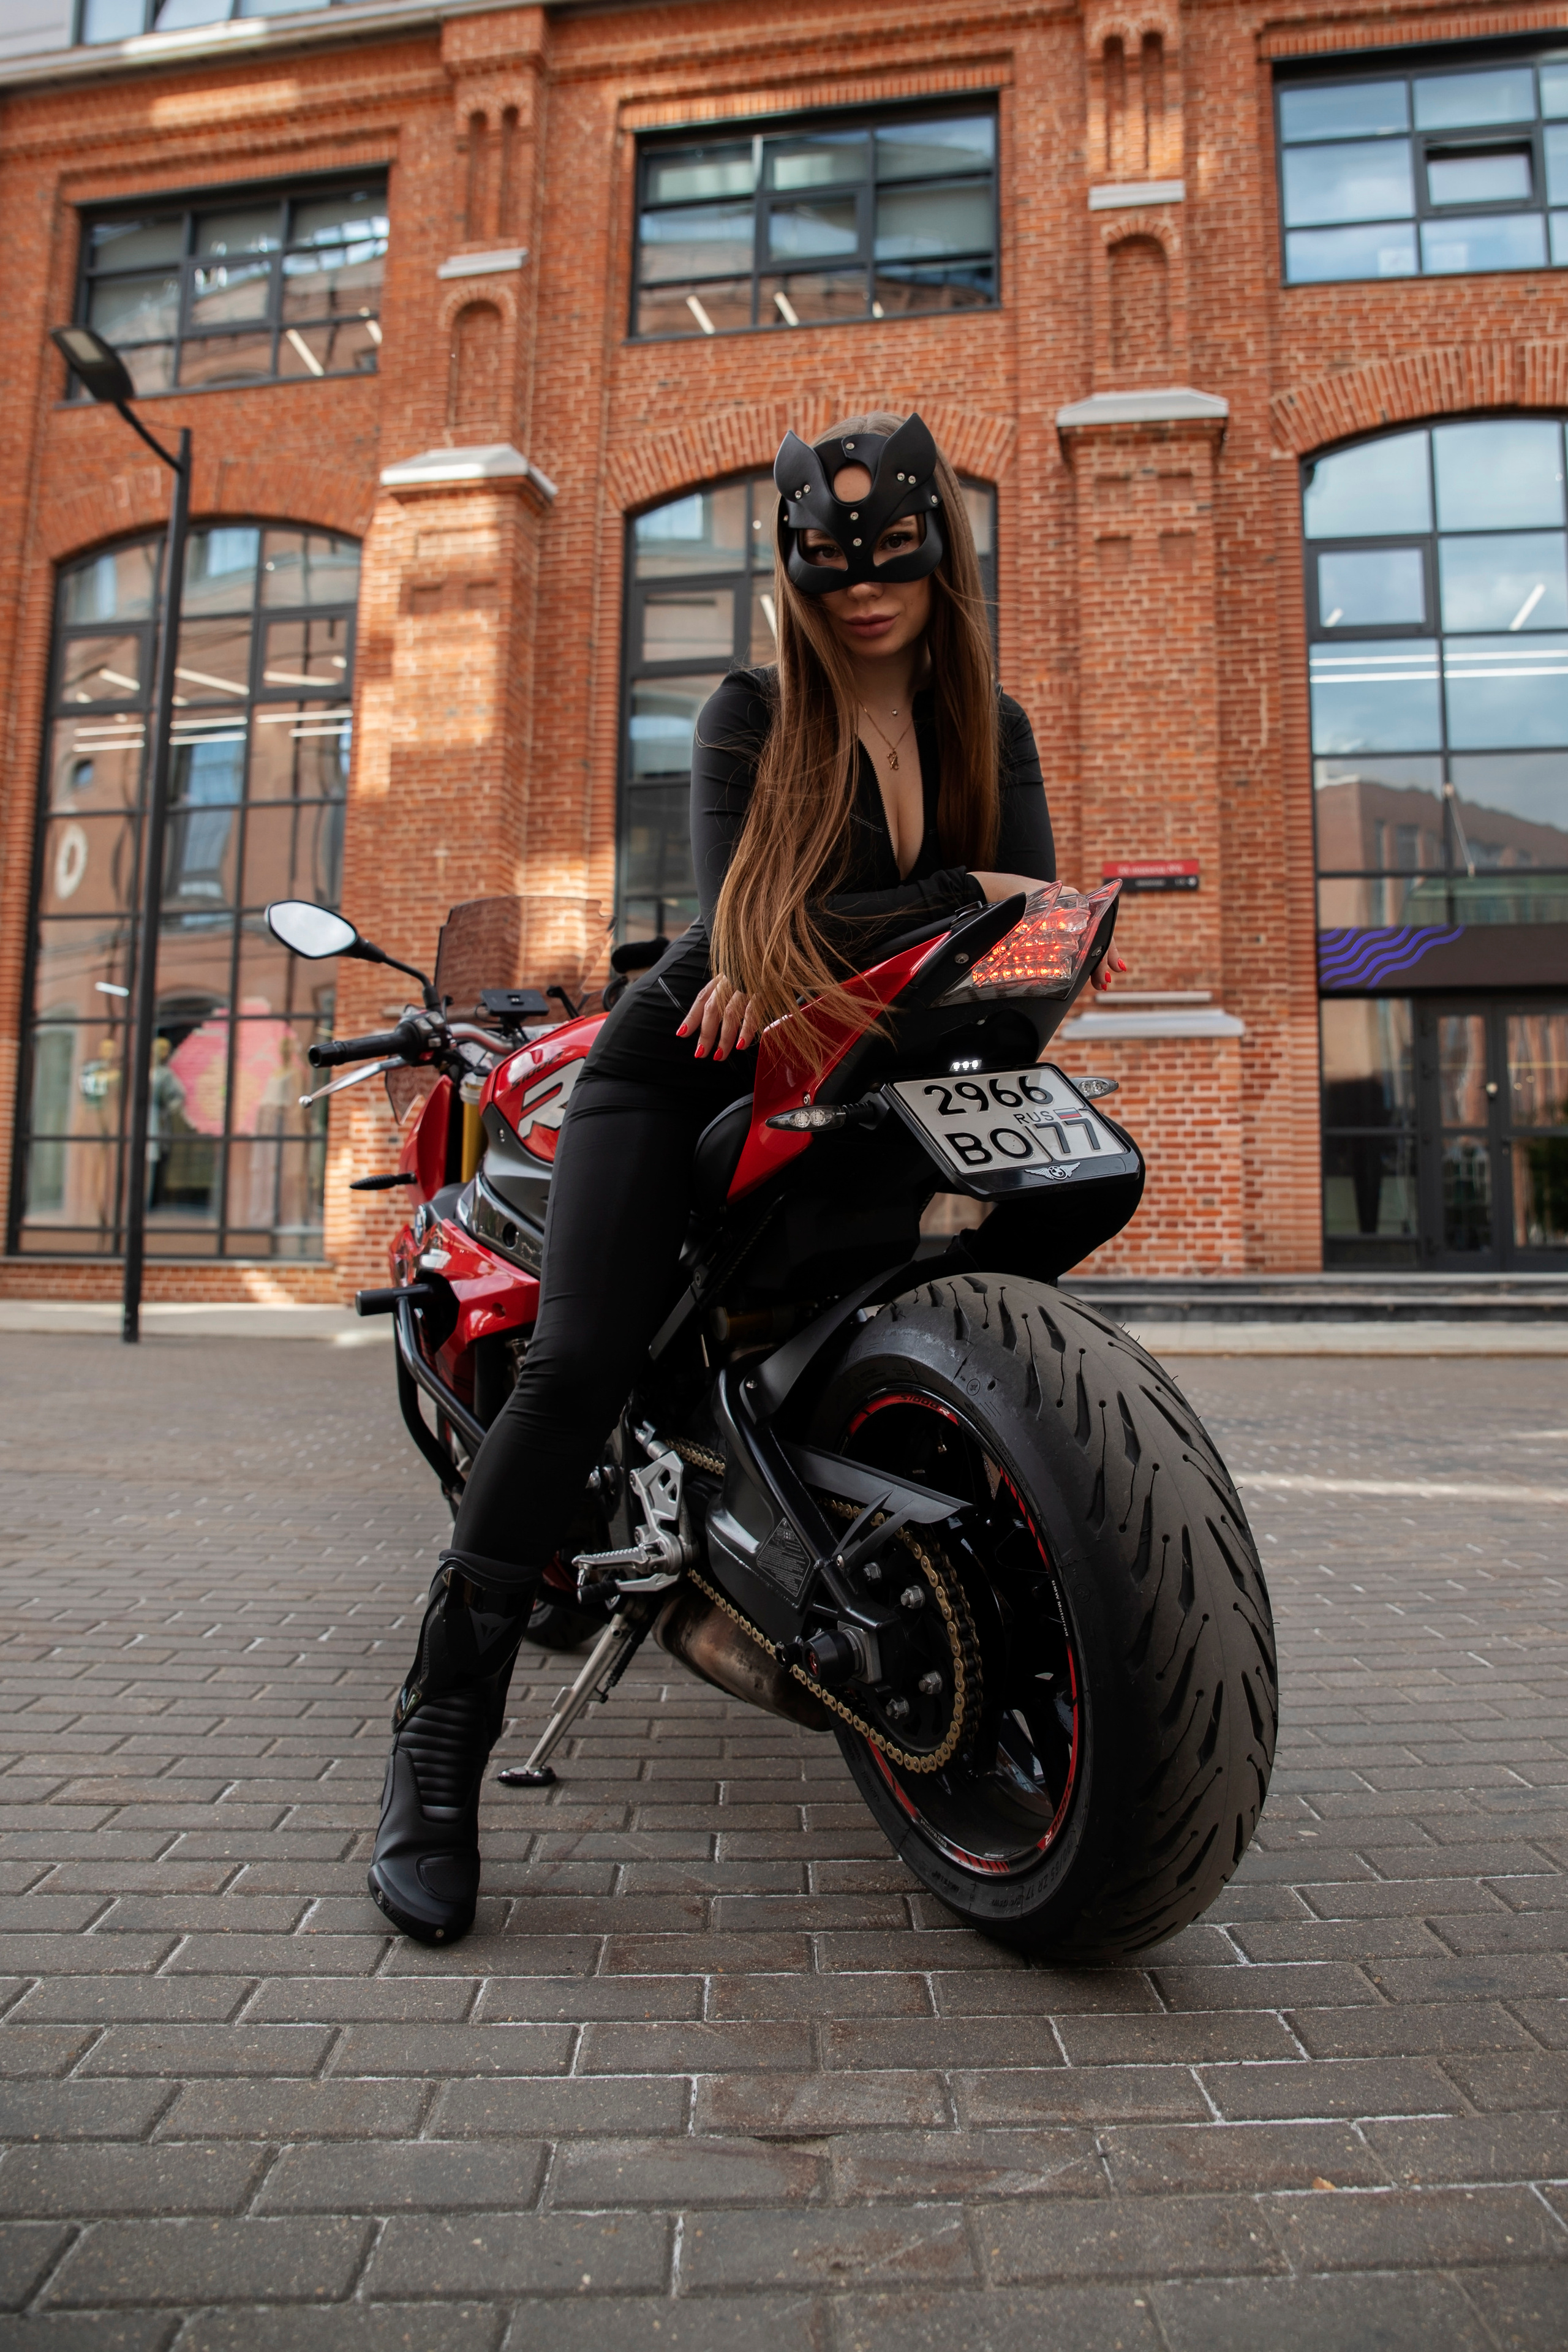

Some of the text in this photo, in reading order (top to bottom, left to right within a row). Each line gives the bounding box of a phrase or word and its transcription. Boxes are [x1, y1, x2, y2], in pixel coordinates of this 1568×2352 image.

[518, 1057, 586, 1140] R
[924, 1076, 1054, 1117] 2966
[1013, 1111, 1054, 1124] RUS
[1035, 1118, 1101, 1154] 77
[944, 1128, 1035, 1166] BO
[1051, 1580, 1069, 1637] BMW Motorrad
